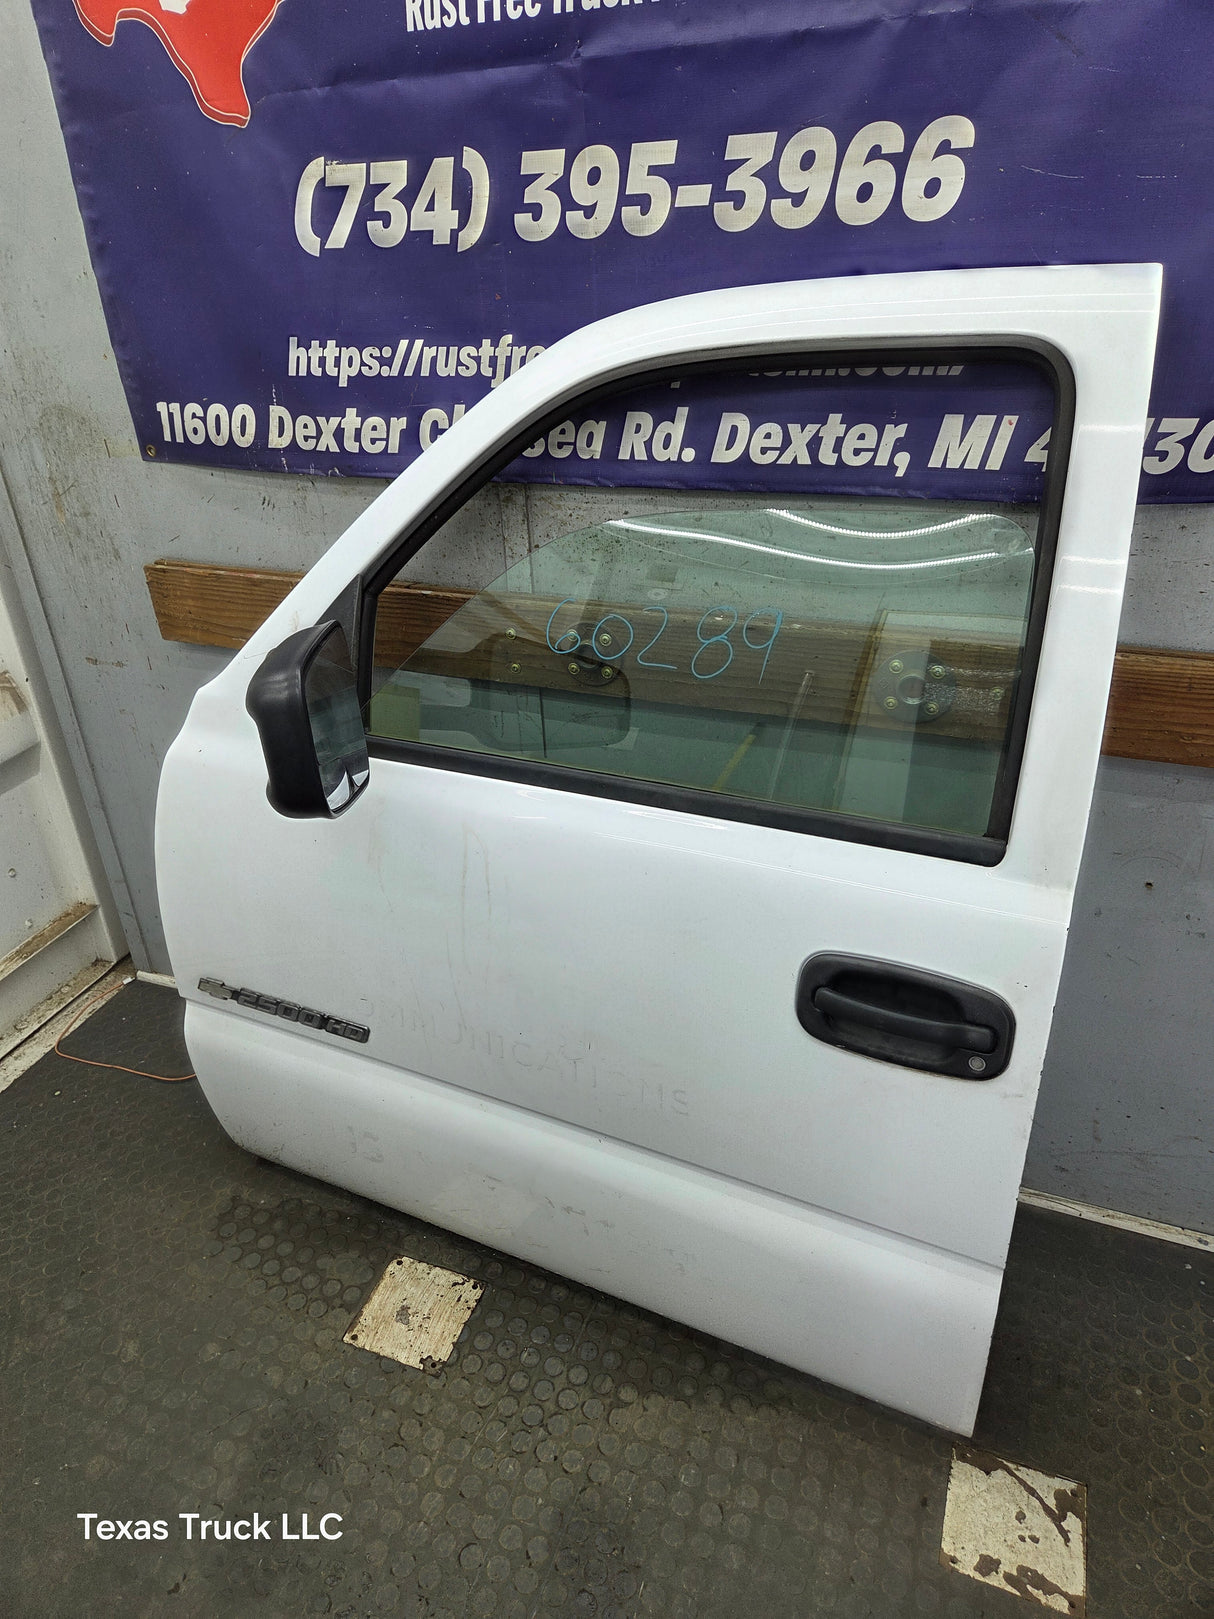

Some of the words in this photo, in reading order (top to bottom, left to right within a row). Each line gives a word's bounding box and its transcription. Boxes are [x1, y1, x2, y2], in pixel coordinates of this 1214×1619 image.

[294, 146, 490, 257] (734)
[514, 115, 975, 241] 395-3966
[156, 402, 256, 448] 11600
[268, 405, 407, 454] Dexter
[618, 407, 696, 462] Rd.
[711, 412, 910, 477] Dexter,
[927, 414, 1019, 470] MI
[546, 598, 783, 684] 60289
[237, 987, 324, 1029] 2500
[325, 1015, 370, 1043] HD
